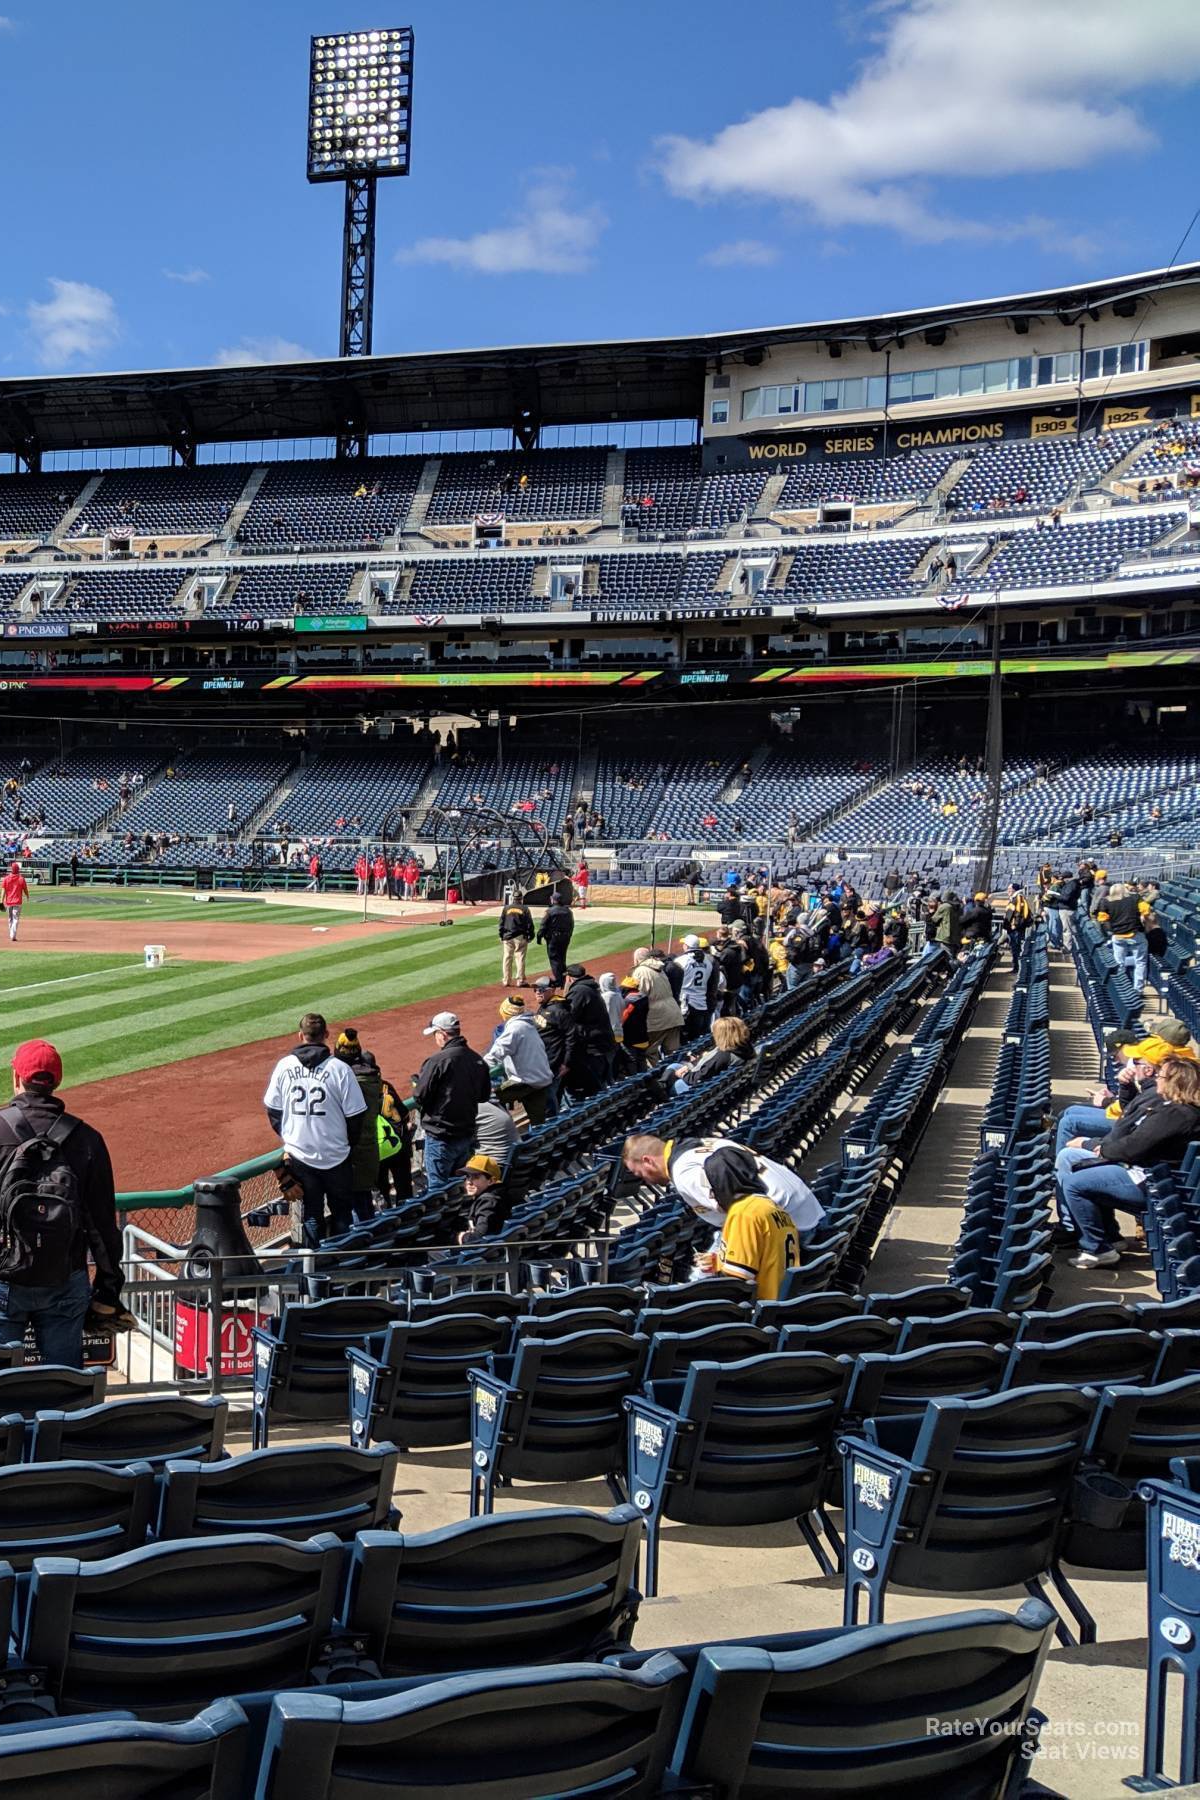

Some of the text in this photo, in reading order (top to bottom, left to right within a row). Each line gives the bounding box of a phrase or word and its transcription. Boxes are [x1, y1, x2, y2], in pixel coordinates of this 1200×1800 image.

[1108, 411, 1139, 424] 1925
[1035, 420, 1067, 433] 1909
[749, 423, 1004, 460] WORLD SERIES CHAMPIONS
[597, 611, 660, 622] RIVENDALE
[677, 608, 766, 619] SUITE LEVEL
[18, 625, 65, 634] PNC BANK
[225, 620, 259, 632] 11:40
[203, 681, 245, 689] OPENING DAY
[681, 675, 715, 684] OPENING
[694, 971, 703, 986] 2
[287, 1065, 330, 1083] ARCHER
[291, 1086, 326, 1116] 22
[88, 1338, 110, 1346] FIELD
[237, 1360, 253, 1368] bac
[854, 1462, 892, 1490] PIRATES
[638, 1494, 646, 1505] G
[858, 1552, 869, 1567] H
[1168, 1623, 1180, 1638] J
